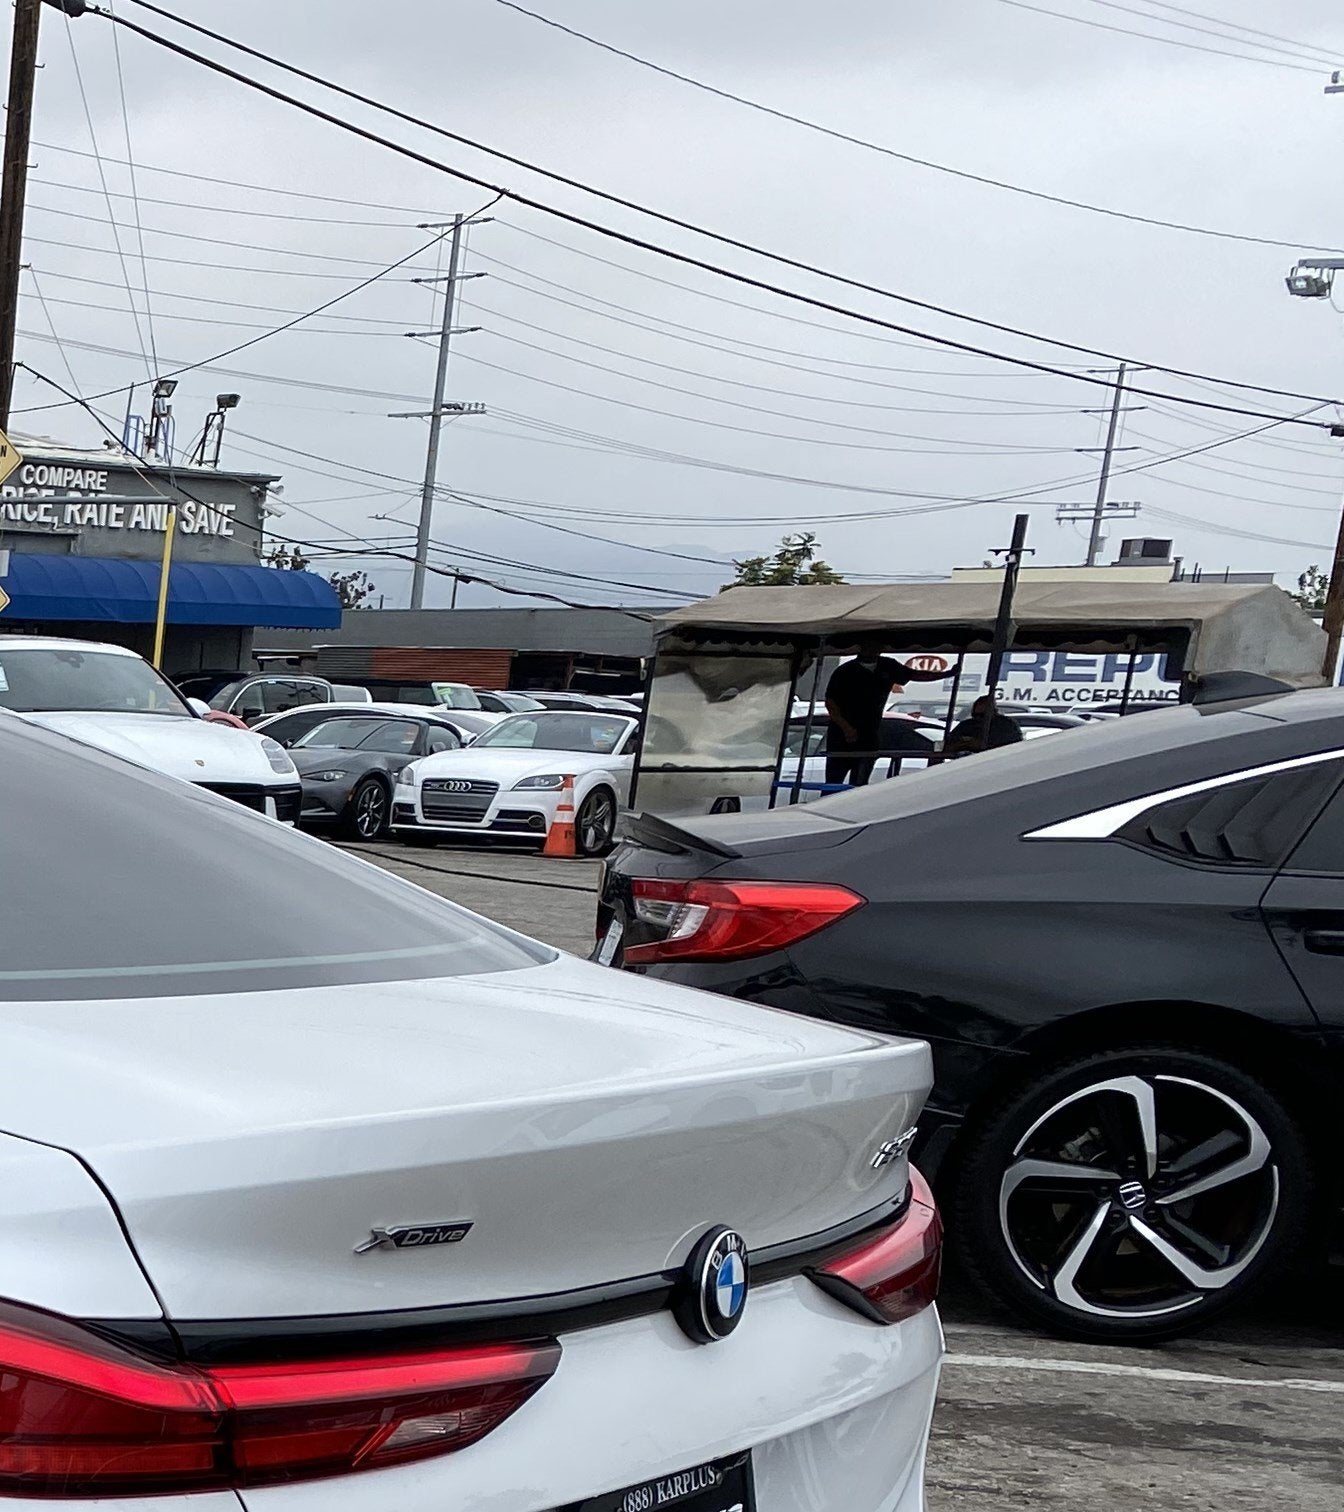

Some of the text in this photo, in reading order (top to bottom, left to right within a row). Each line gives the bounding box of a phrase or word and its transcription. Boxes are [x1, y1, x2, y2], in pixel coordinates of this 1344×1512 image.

[20, 464, 108, 491] COMPARE
[0, 485, 59, 530] RICE,
[180, 500, 236, 536] SAVE
[912, 658, 942, 673] KIA
[657, 1465, 716, 1505] KARPLUS
